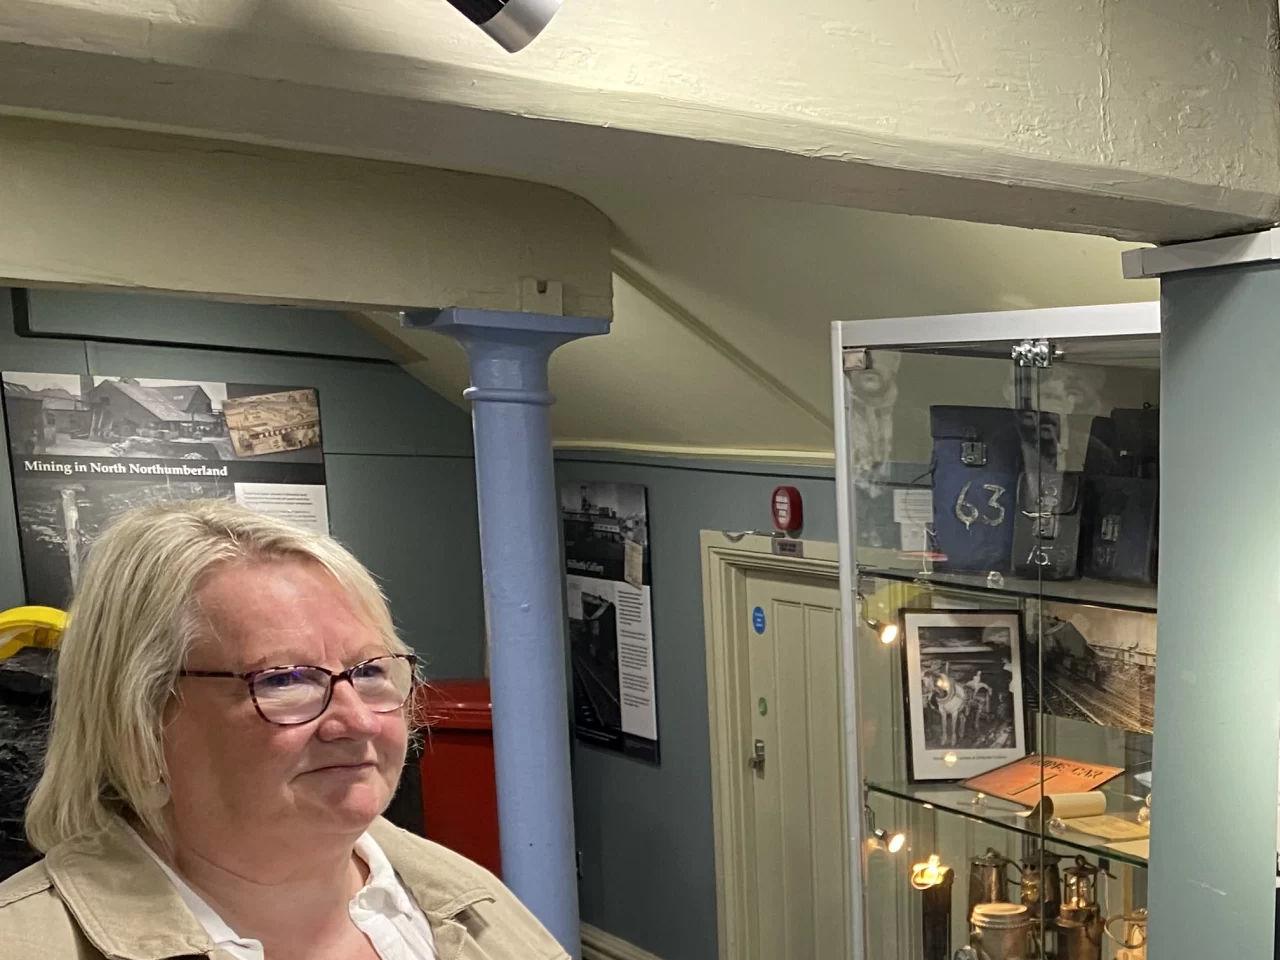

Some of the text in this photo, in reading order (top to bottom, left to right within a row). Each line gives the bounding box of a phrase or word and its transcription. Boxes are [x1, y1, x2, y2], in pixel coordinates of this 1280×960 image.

[25, 461, 228, 476] Mining in North Northumberland
[955, 481, 1006, 528] 63
